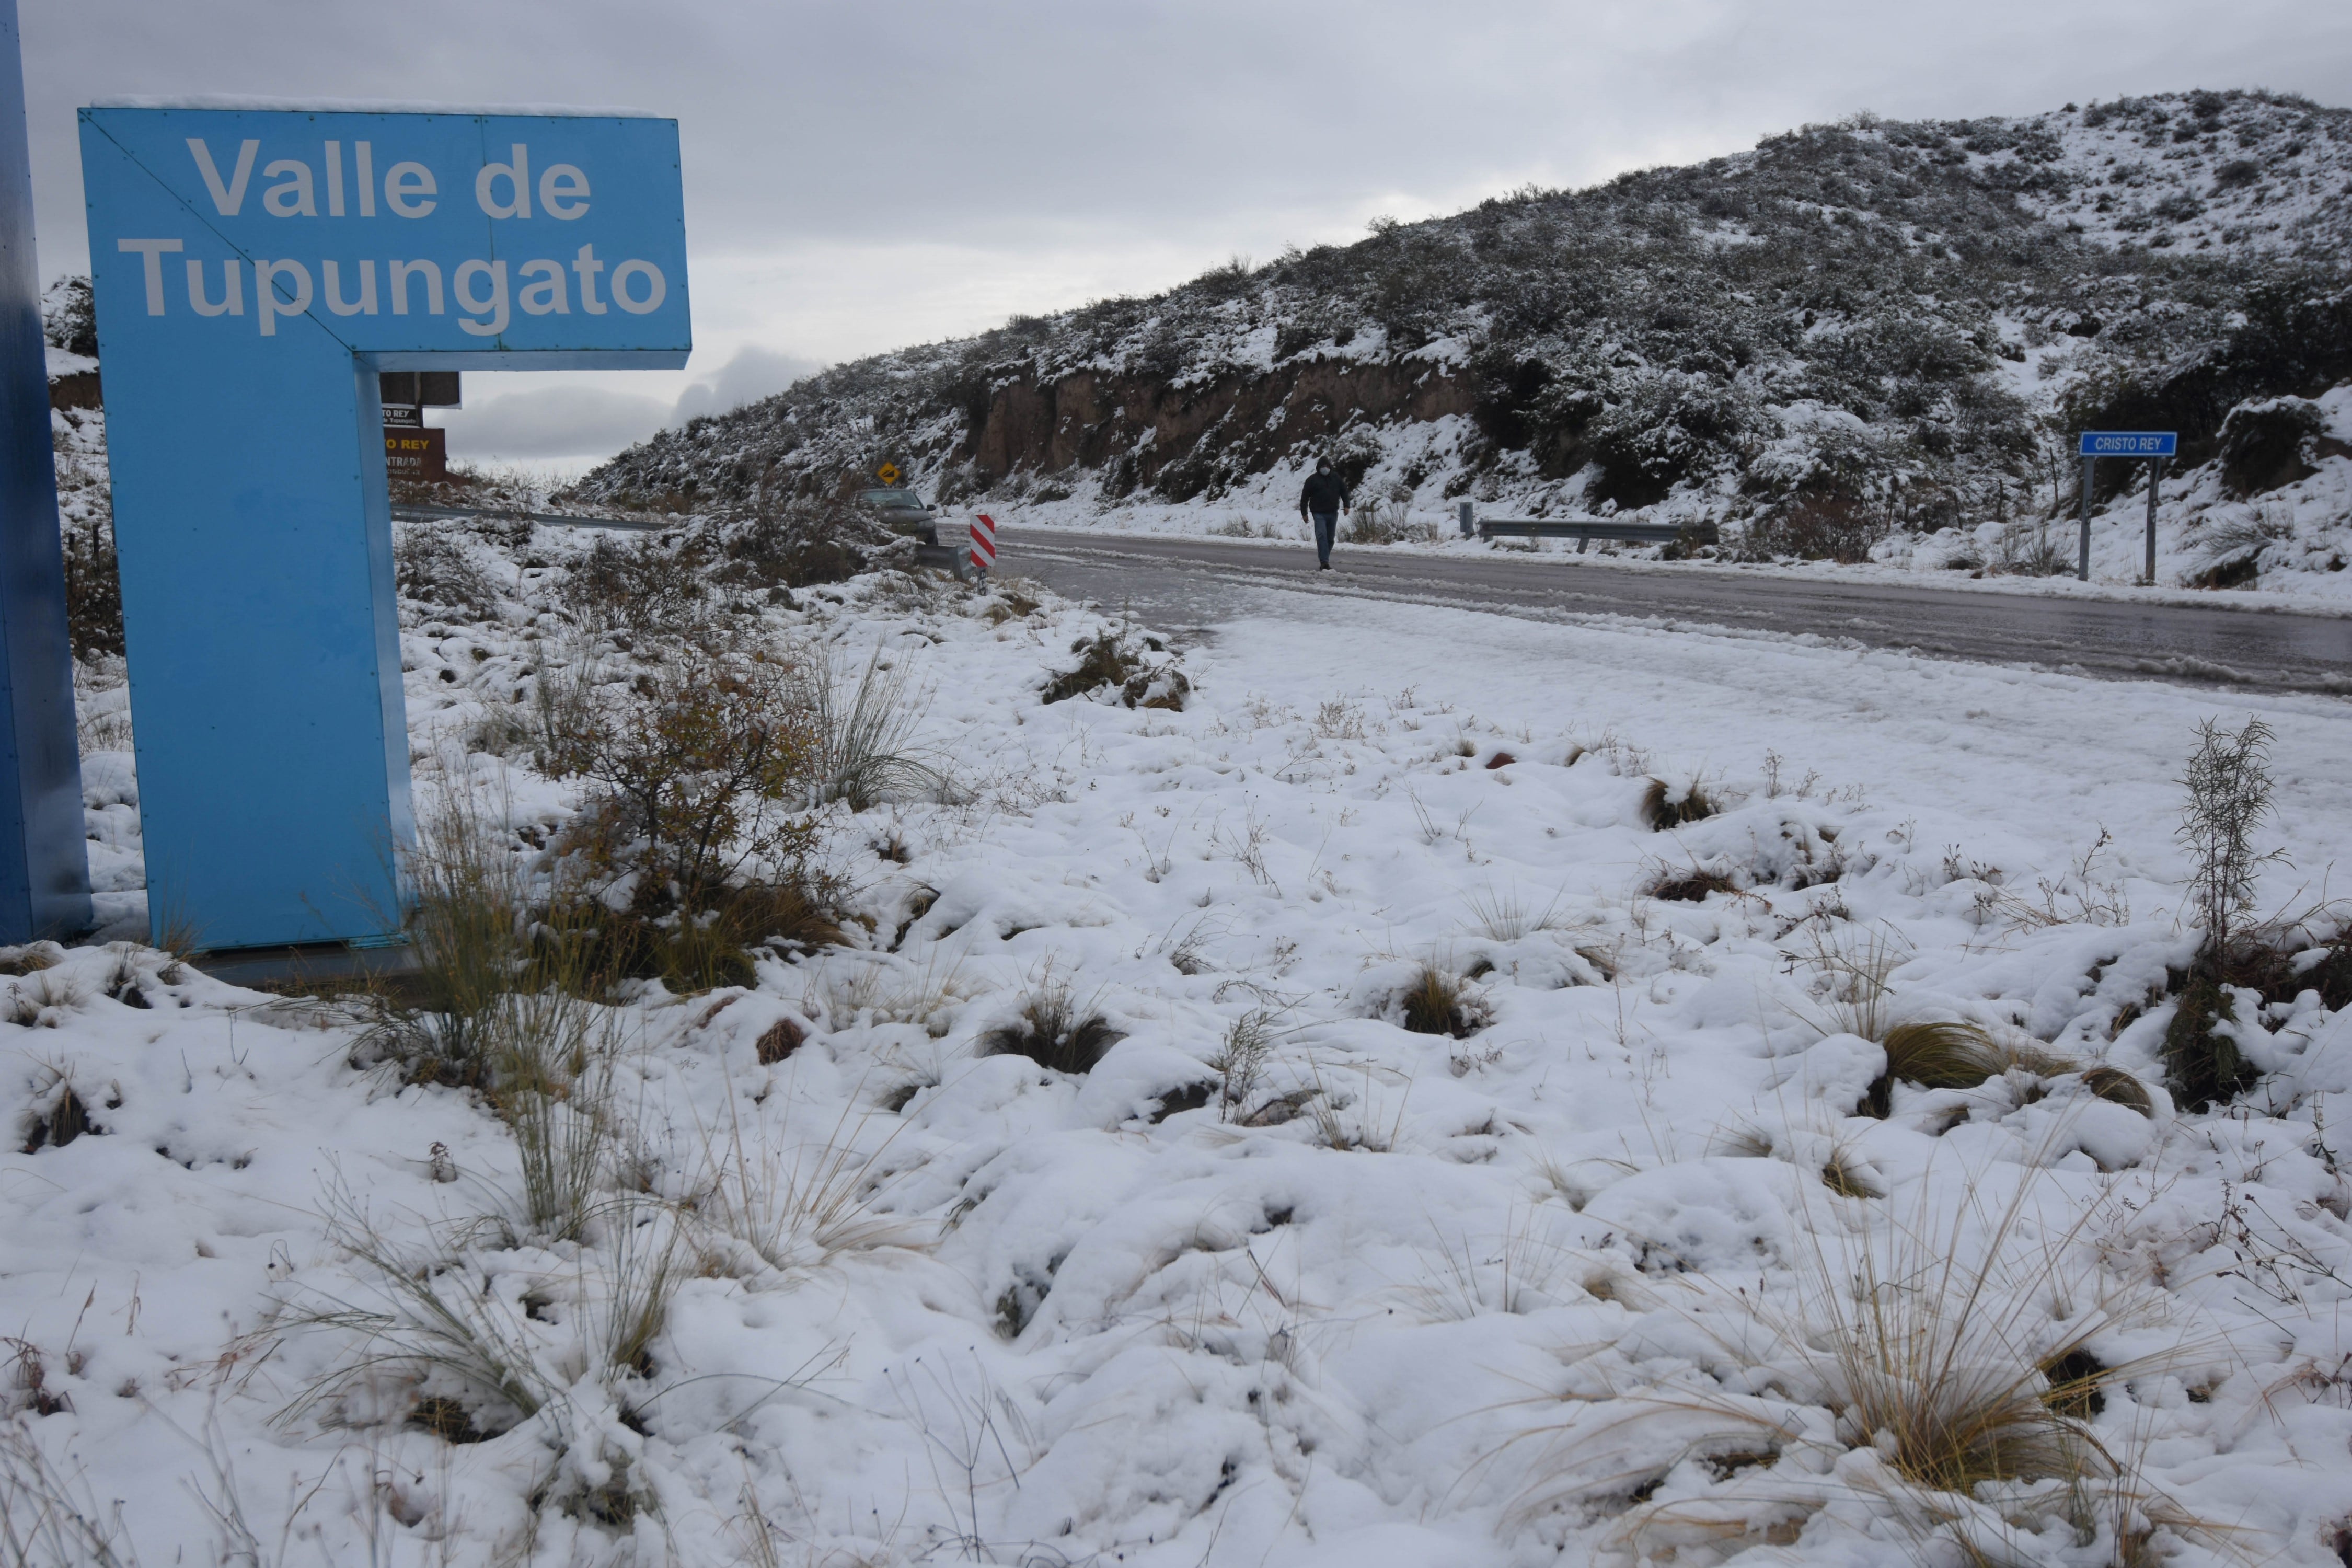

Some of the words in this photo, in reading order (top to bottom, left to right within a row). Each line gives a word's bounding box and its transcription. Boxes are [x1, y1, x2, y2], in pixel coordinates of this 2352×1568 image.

[186, 138, 437, 220] Valle
[476, 143, 591, 221] de
[118, 238, 666, 337] Tupungato
[385, 439, 397, 449] O
[401, 439, 429, 450] REY
[2095, 437, 2137, 451] CRISTO
[2139, 437, 2162, 451] REY
